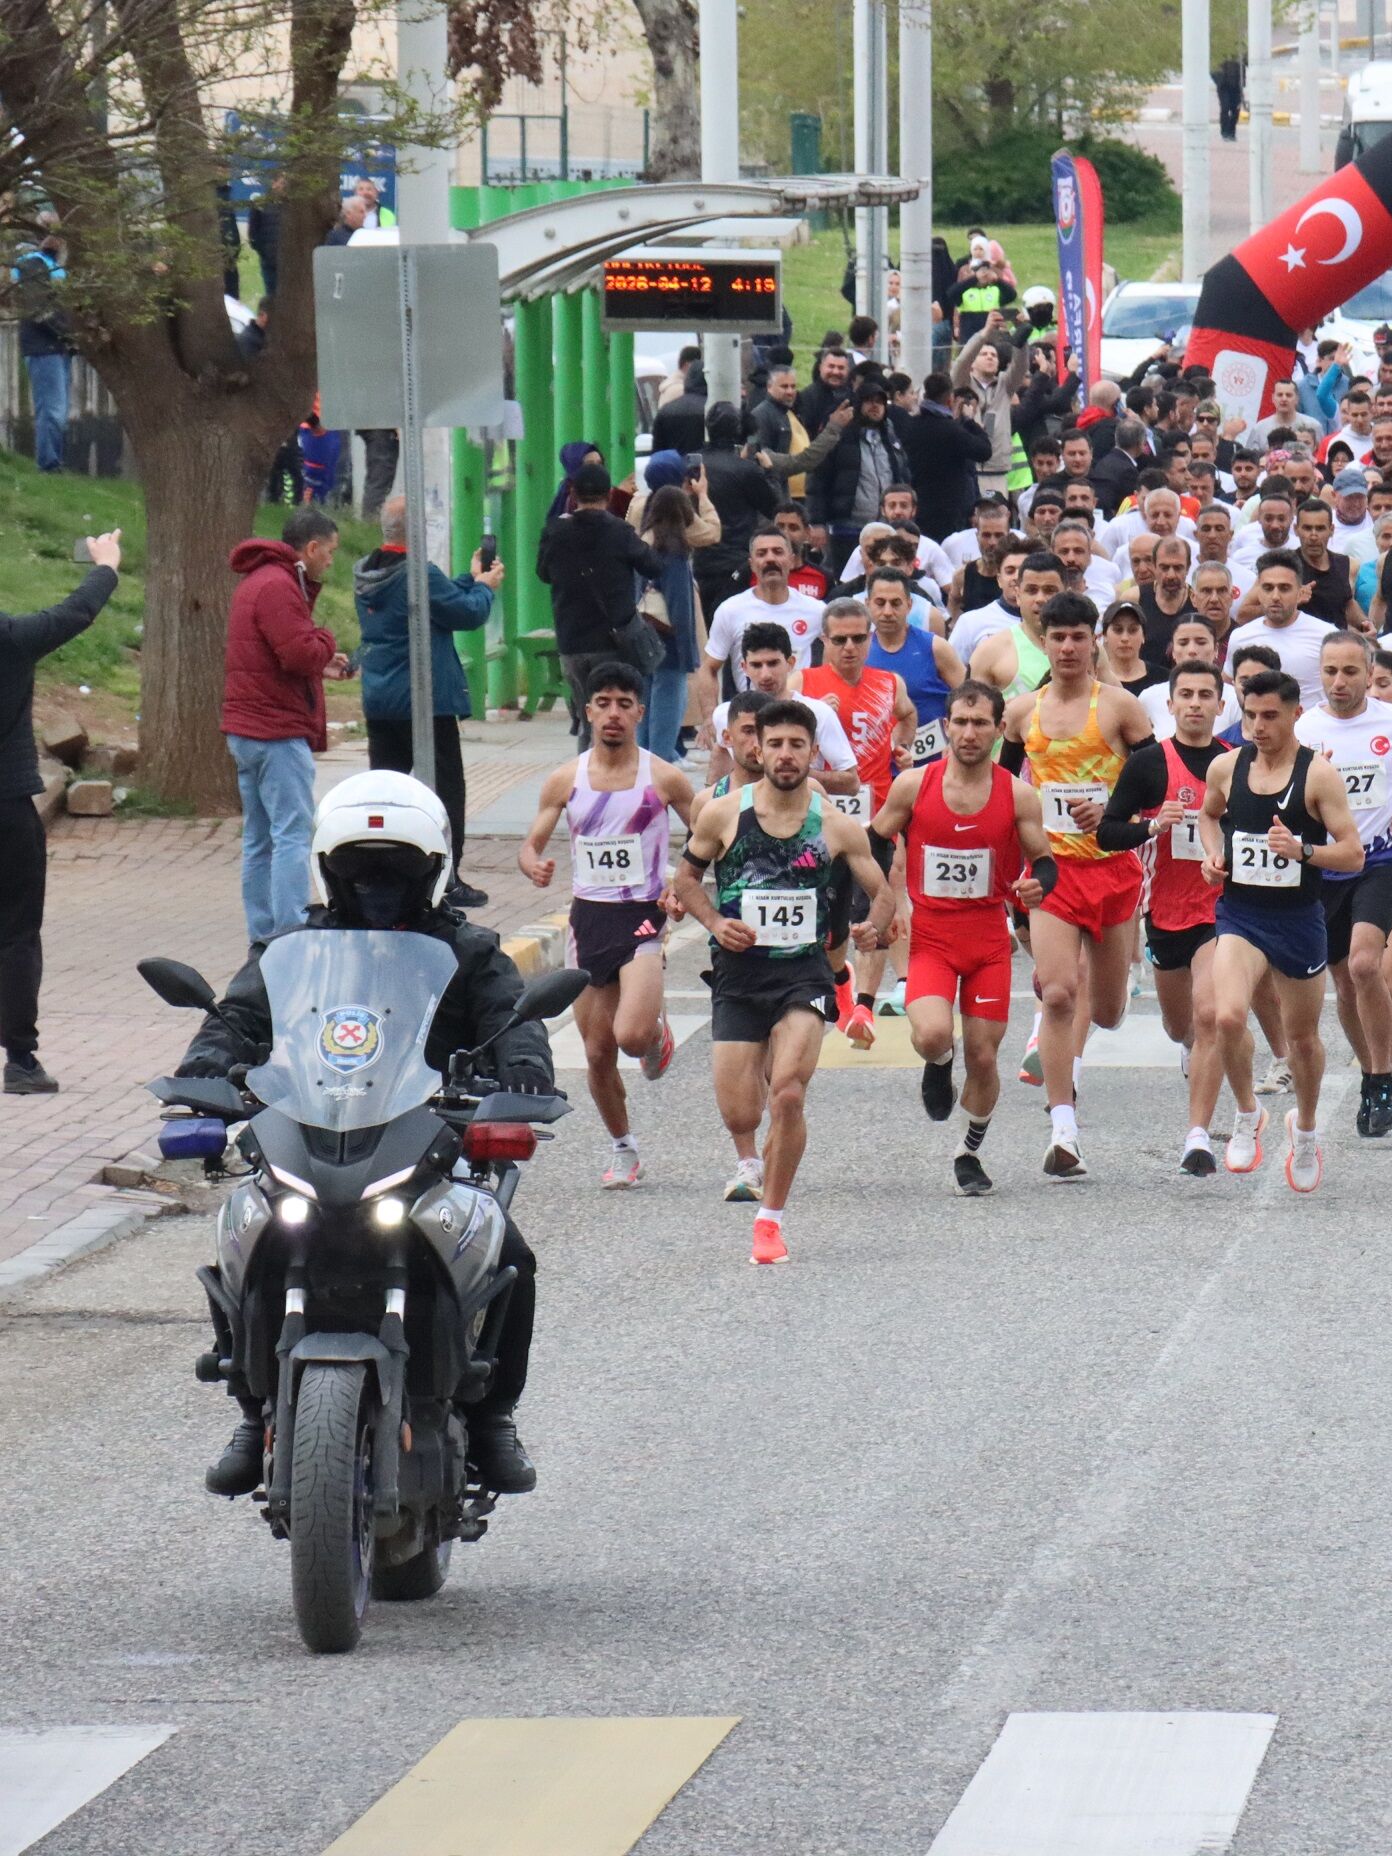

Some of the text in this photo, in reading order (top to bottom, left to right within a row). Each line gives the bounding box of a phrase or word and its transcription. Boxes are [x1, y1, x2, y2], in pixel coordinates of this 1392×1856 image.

[605, 274, 713, 292] 2026-04-12
[852, 711, 868, 742] 5
[586, 848, 631, 870] 148
[757, 905, 804, 927] 145
